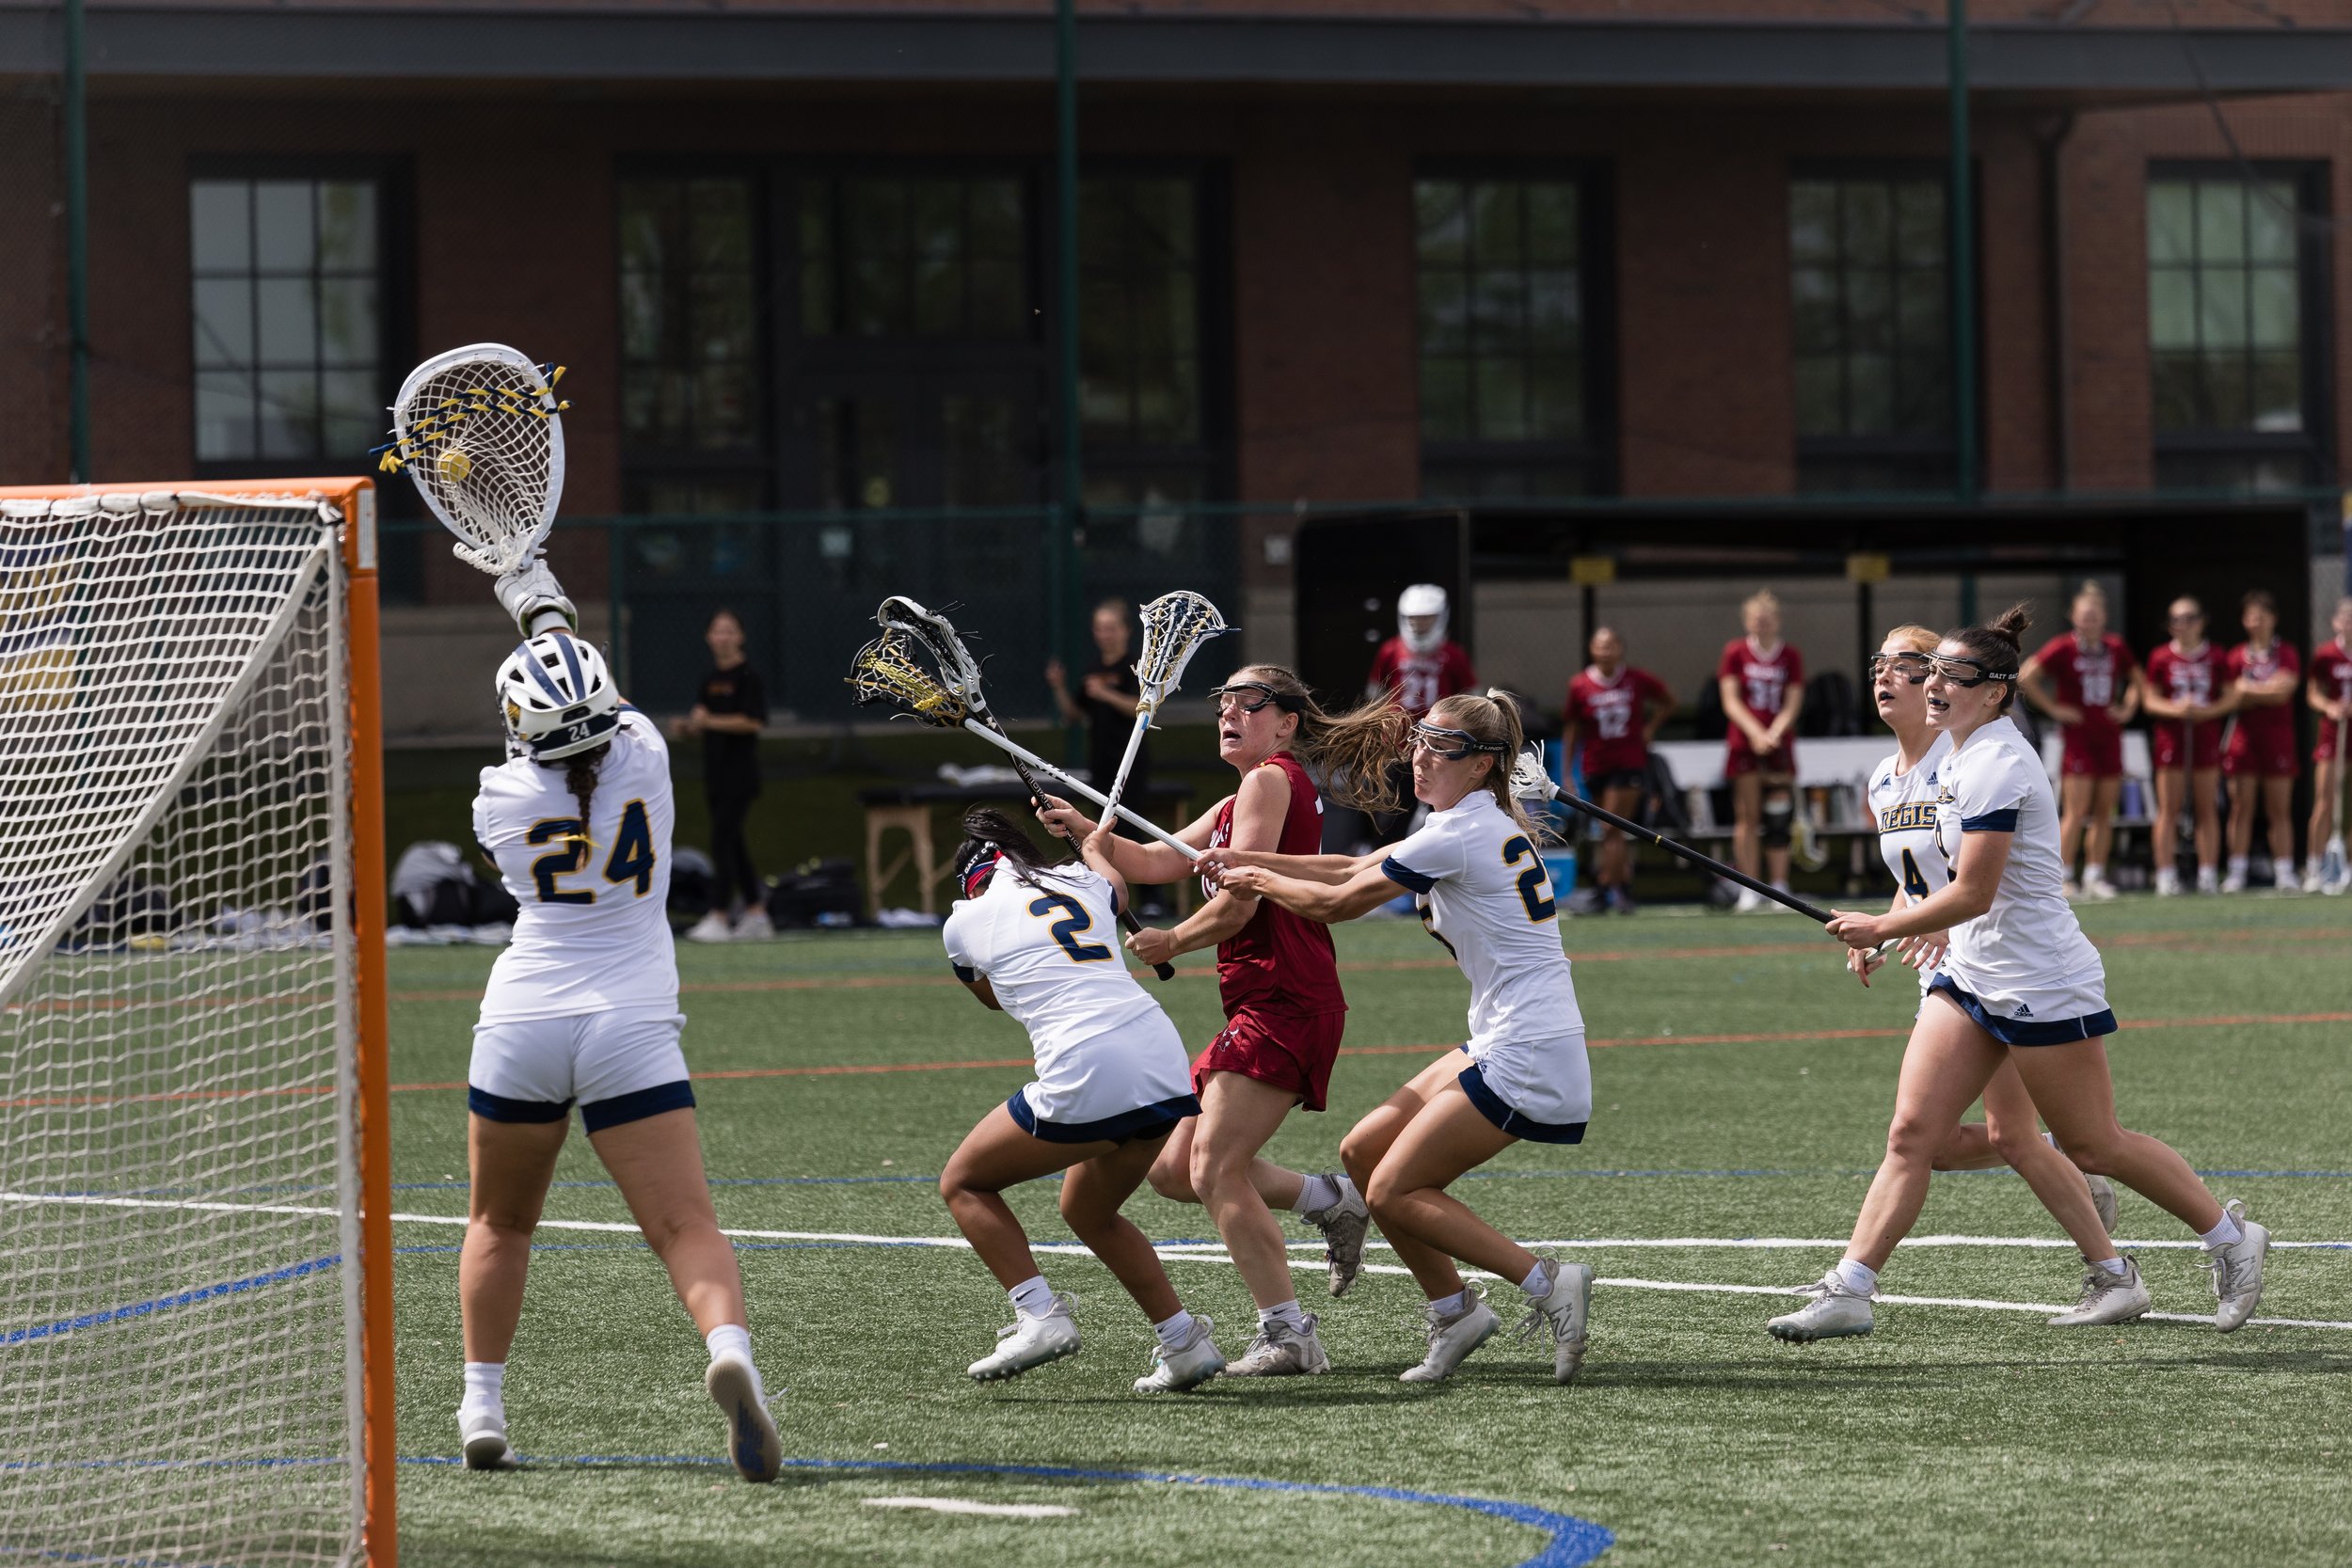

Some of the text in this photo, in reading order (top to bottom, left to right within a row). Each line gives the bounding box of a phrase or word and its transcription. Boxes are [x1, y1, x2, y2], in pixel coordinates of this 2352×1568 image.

[567, 721, 591, 742] 24
[1879, 801, 1938, 835] REGIS
[525, 798, 657, 905] 24
[1901, 847, 1931, 902] 4
[1025, 891, 1115, 964] 2
